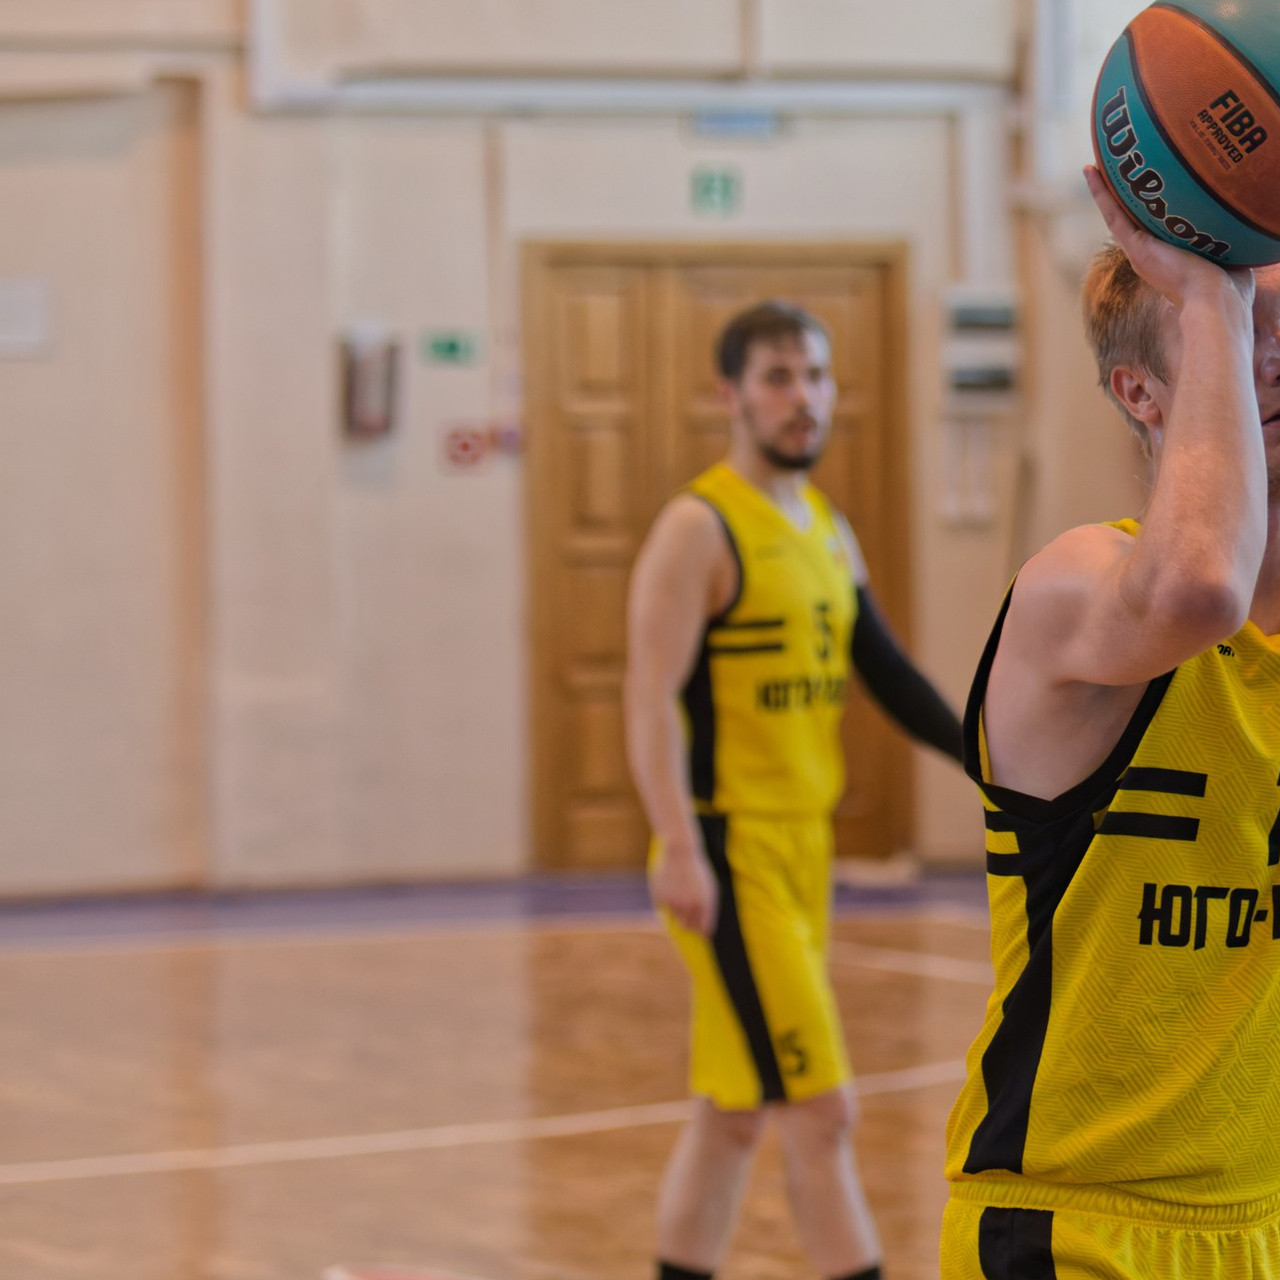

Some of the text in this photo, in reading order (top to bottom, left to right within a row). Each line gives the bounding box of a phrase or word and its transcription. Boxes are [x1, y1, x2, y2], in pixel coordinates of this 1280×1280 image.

[1197, 109, 1244, 163] APPROVED
[1209, 89, 1268, 154] FIBA
[1101, 85, 1232, 259] Wilson
